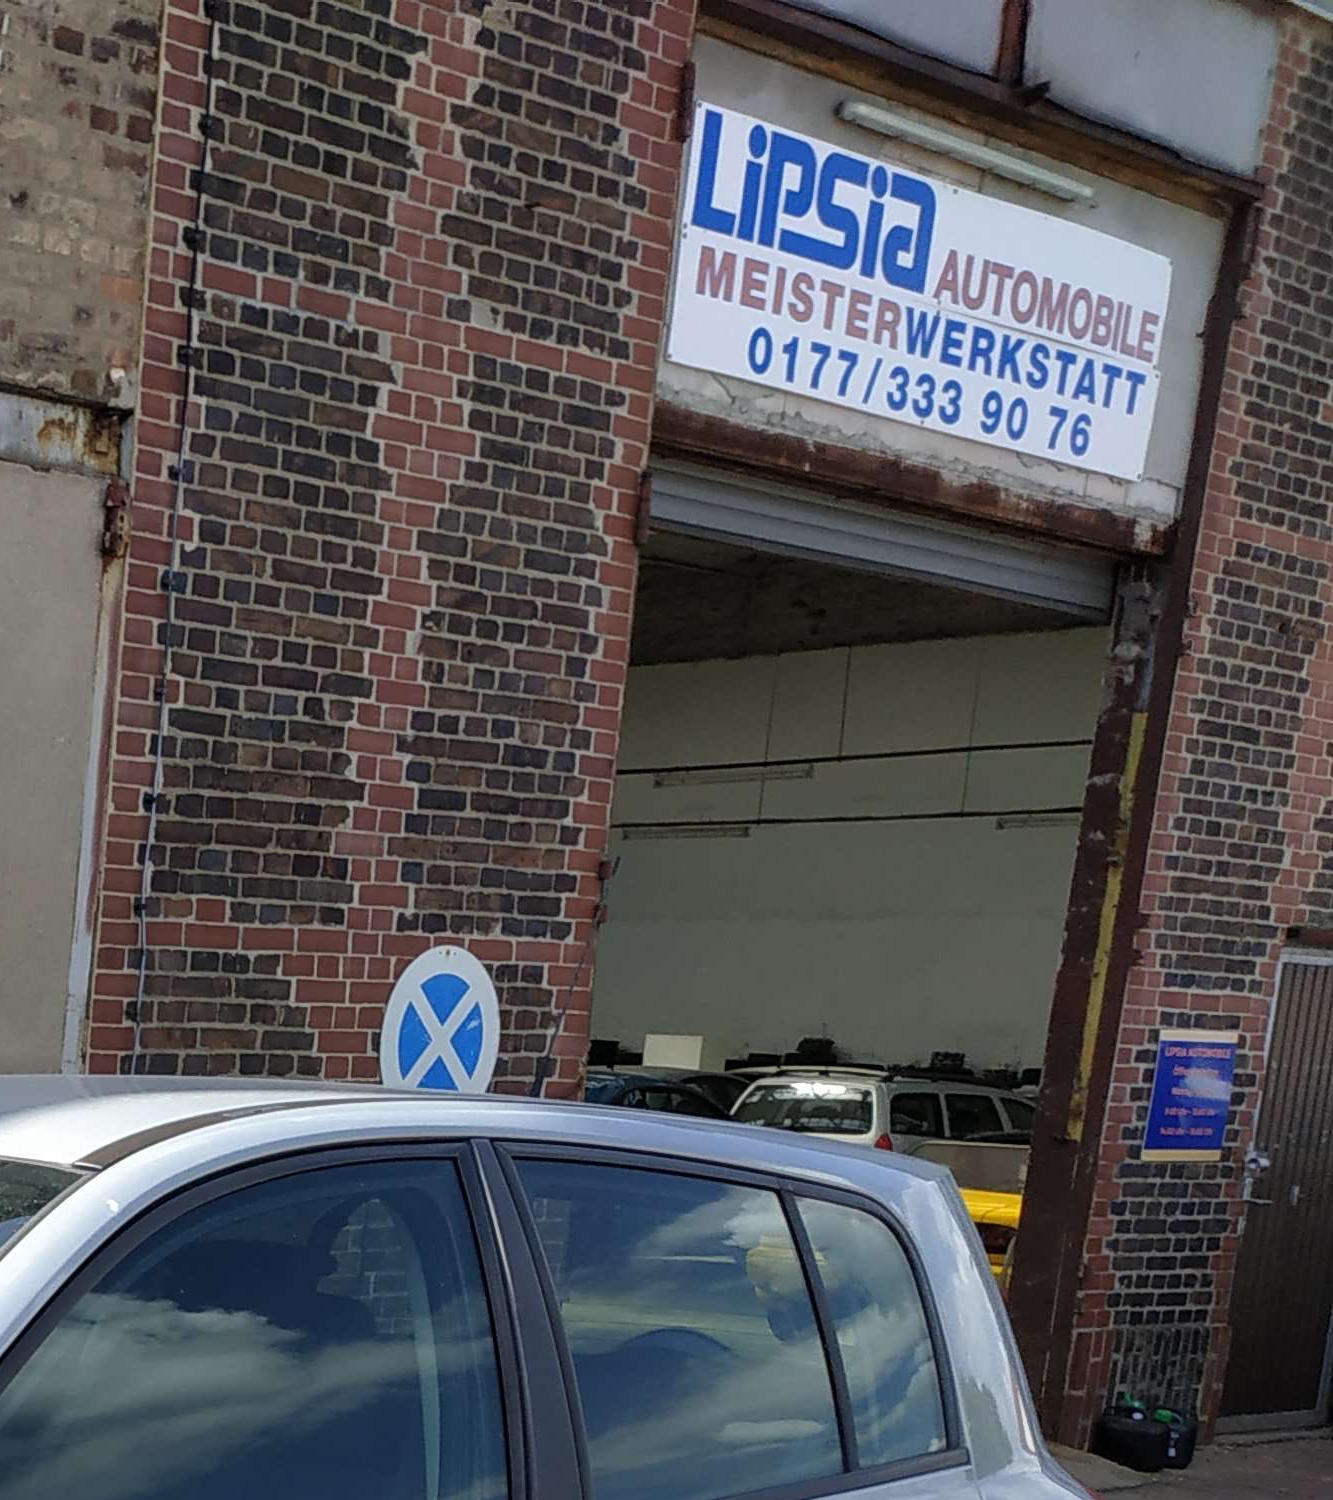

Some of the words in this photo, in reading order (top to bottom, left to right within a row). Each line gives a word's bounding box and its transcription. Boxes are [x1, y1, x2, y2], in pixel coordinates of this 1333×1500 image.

[695, 245, 1147, 415] MEISTERWERKSTATT
[933, 248, 1160, 364] AUTOMOBILE
[748, 327, 962, 426] 0177/333
[981, 390, 1029, 441] 90
[1047, 405, 1091, 456] 76
